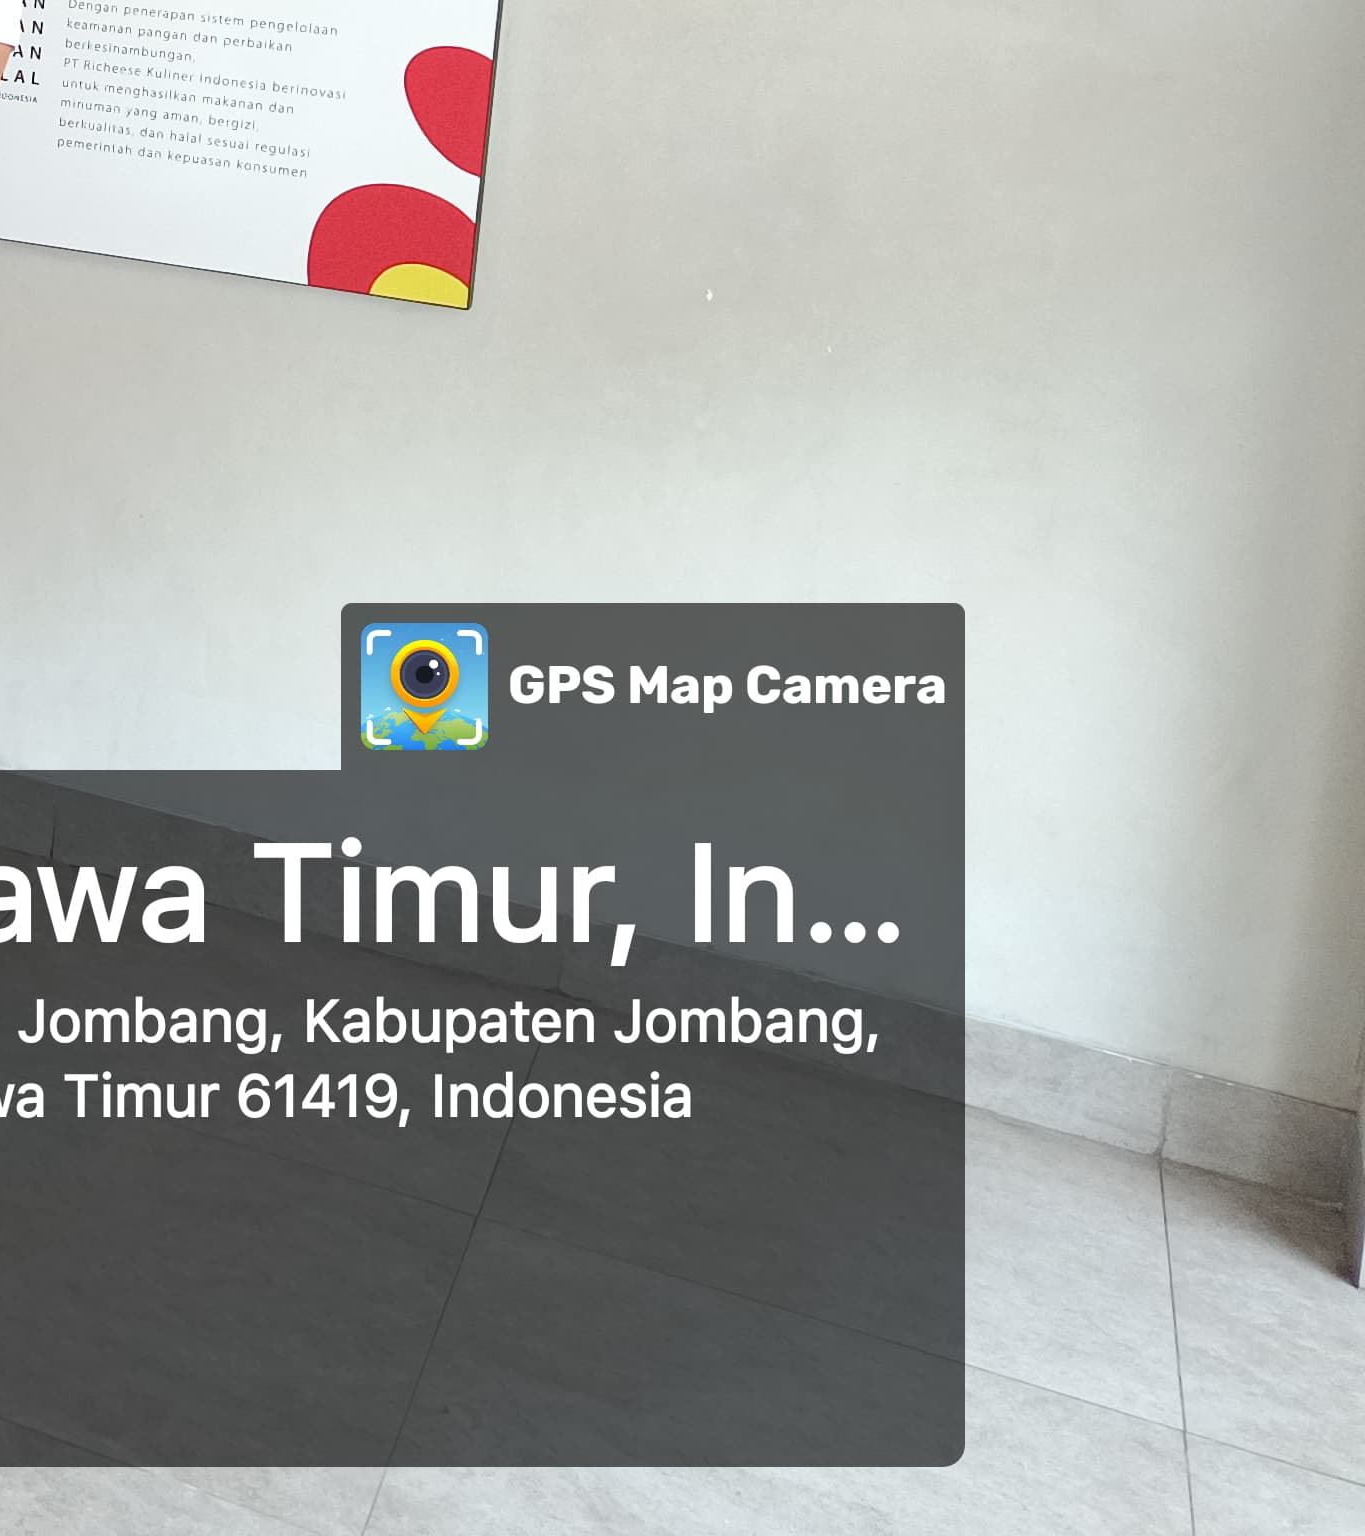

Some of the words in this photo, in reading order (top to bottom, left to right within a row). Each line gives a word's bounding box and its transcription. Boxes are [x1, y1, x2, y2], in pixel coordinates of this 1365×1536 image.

[67, 17, 132, 34] keamanan
[138, 28, 186, 41] pangan
[193, 32, 217, 44] dan
[224, 37, 292, 52] perbaikan
[69, 0, 117, 14] Dengan
[124, 7, 194, 21] penerapan
[201, 15, 244, 26] sistem
[250, 20, 337, 36] pengelolaan
[64, 58, 79, 68] PT
[84, 60, 141, 76] Richeese
[147, 67, 193, 82] Kuliner
[200, 73, 265, 90] Indonesia
[273, 81, 345, 99] berinovasi
[61, 100, 120, 113] minuman
[126, 108, 157, 120] yang
[63, 80, 98, 91] untuk
[105, 85, 195, 102] menghasilkan
[203, 96, 262, 110] makanan
[269, 102, 293, 114] dan
[58, 139, 132, 155] pemerintah
[138, 147, 161, 158] dan
[168, 150, 230, 168] kepuasan
[237, 160, 306, 178] konsumen
[140, 128, 163, 139] dan
[170, 130, 202, 144] halal
[207, 138, 248, 150] sesuai
[256, 144, 309, 158] regulasi
